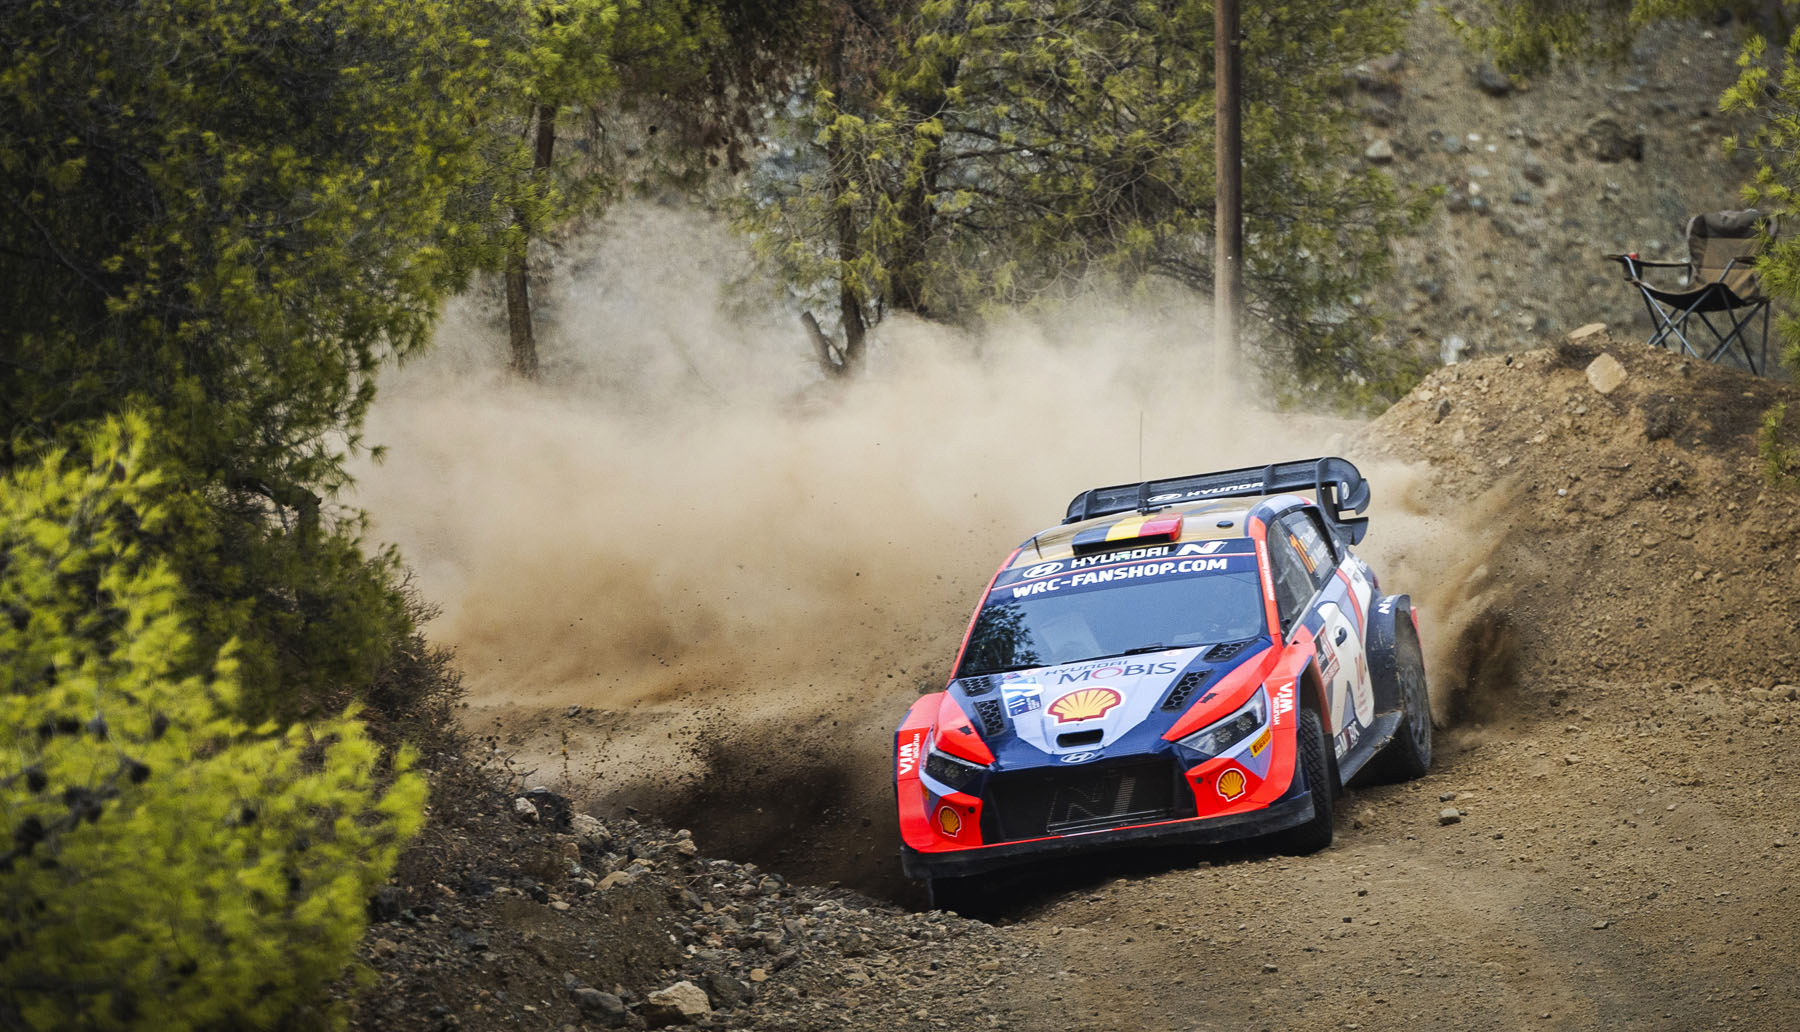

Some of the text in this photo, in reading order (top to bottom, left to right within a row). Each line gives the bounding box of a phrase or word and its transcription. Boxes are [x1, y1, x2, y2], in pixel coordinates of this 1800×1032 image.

[1186, 481, 1264, 497] HYUNDA
[1070, 546, 1168, 568] HYUNDAI
[1012, 558, 1228, 598] WRC-FANSHOP.COM
[1045, 661, 1128, 676] HYUNDAI
[1057, 662, 1177, 685] MOBIS
